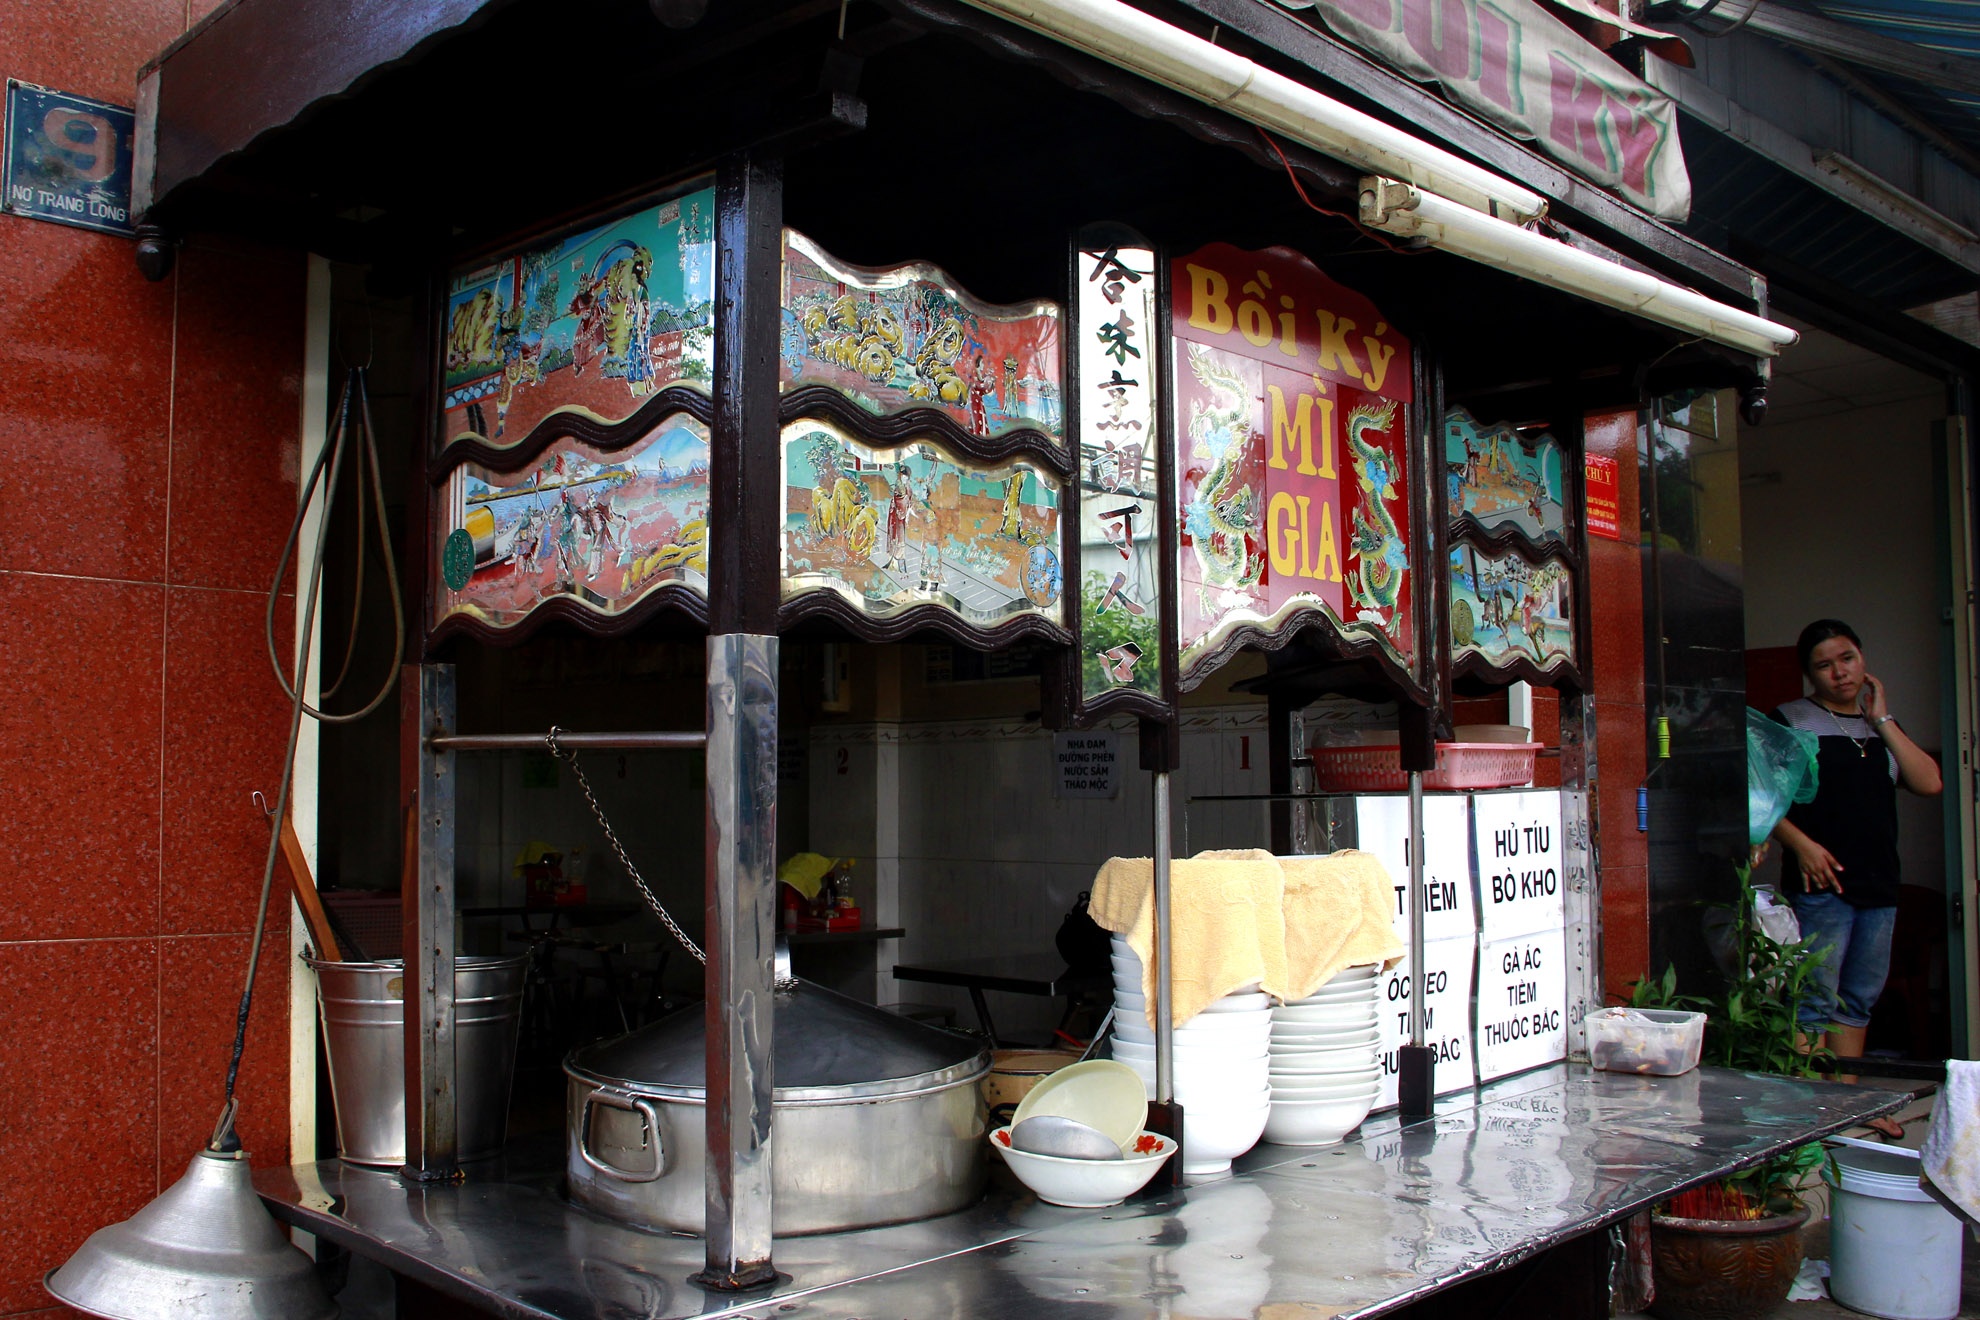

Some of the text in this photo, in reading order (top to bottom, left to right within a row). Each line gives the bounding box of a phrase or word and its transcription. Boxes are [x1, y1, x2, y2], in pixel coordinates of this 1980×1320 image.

[43, 107, 117, 182] 9
[38, 190, 84, 213] TRANG
[90, 201, 126, 222] LONG
[1186, 262, 1298, 357] Bồi
[1267, 372, 1337, 480] MÌ
[1267, 491, 1342, 583] GIA
[837, 747, 848, 775] 2
[1067, 740, 1085, 749] NHA
[1239, 736, 1250, 770] 1
[1495, 820, 1550, 857] HỦ TÍU
[1492, 867, 1557, 904] BÒ KHO
[1503, 944, 1541, 974] GÀ ÁC
[1423, 970, 1447, 995] EO
[1507, 979, 1537, 1007] TIỀM
[1398, 1007, 1433, 1035] TIM
[1484, 1007, 1560, 1046] THUỐC BẮC
